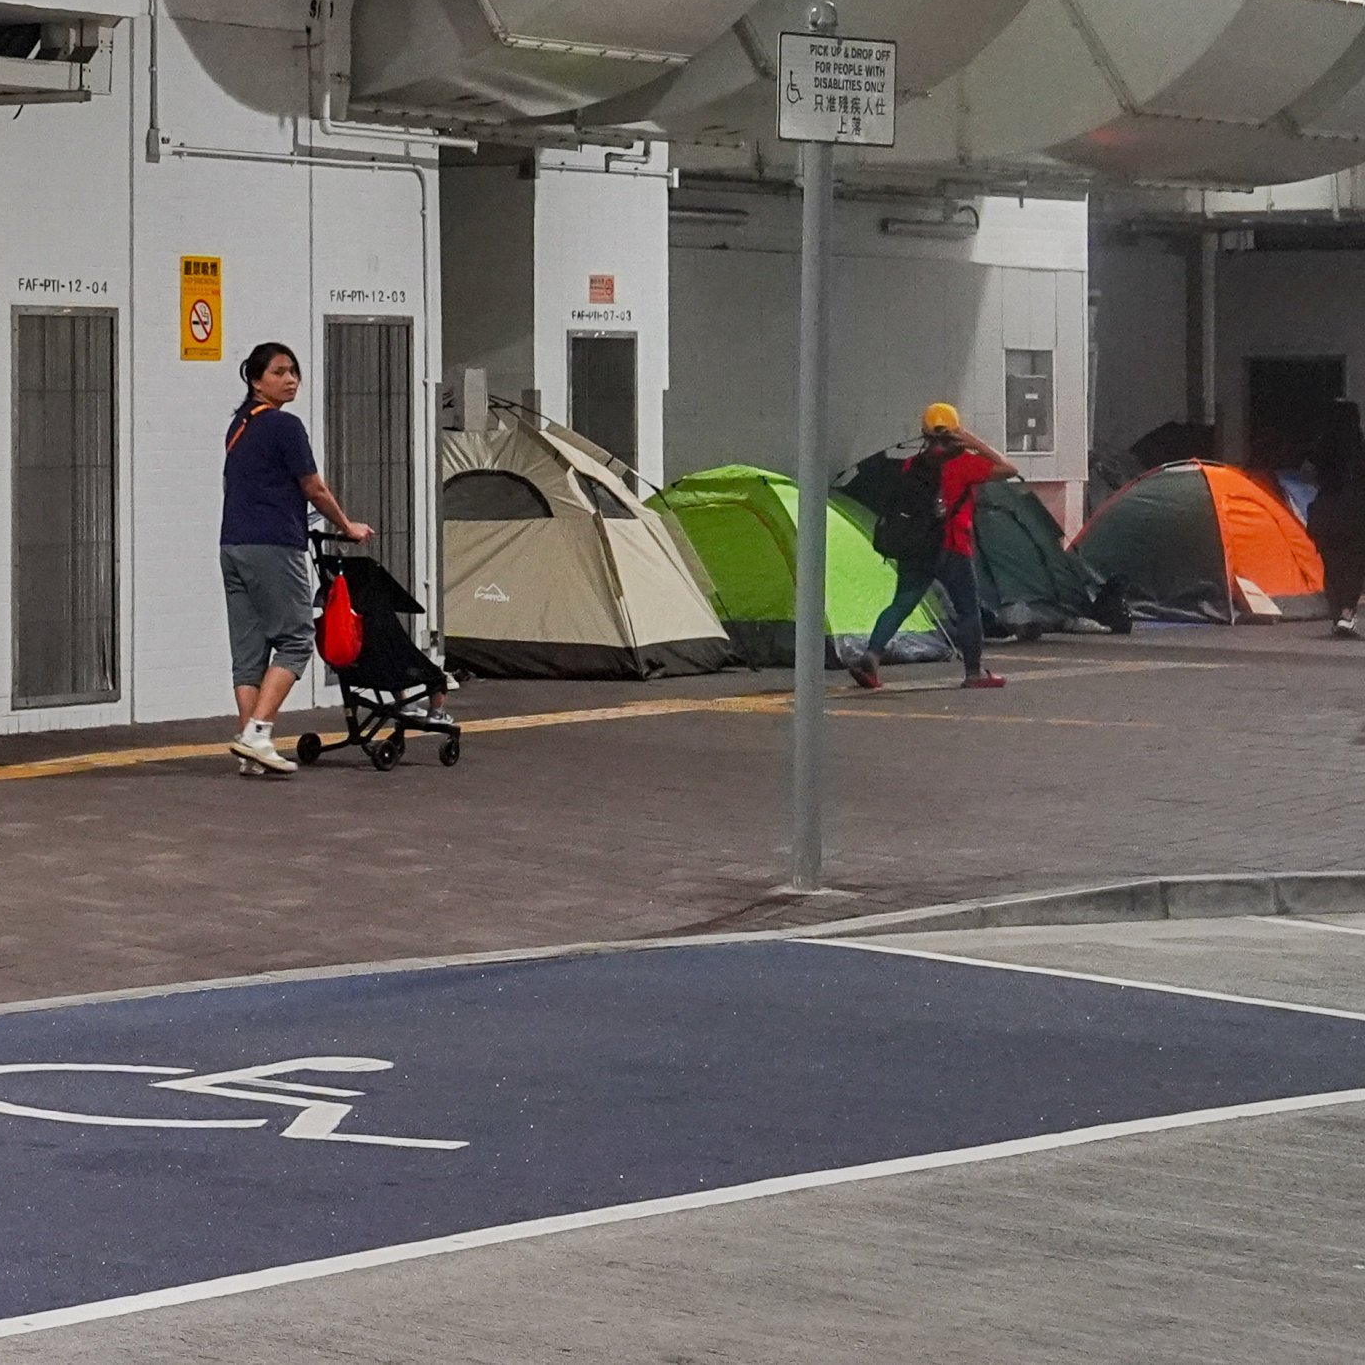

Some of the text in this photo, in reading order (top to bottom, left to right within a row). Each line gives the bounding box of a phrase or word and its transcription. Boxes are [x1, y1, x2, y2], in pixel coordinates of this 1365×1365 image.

[809, 43, 891, 61] PICK UP & DROP OFF
[815, 61, 886, 77] FOR PEOPLE WITH
[864, 81, 886, 93] ONLY
[813, 94, 886, 115] 只准殘疾人仕
[837, 116, 862, 135] 上落
